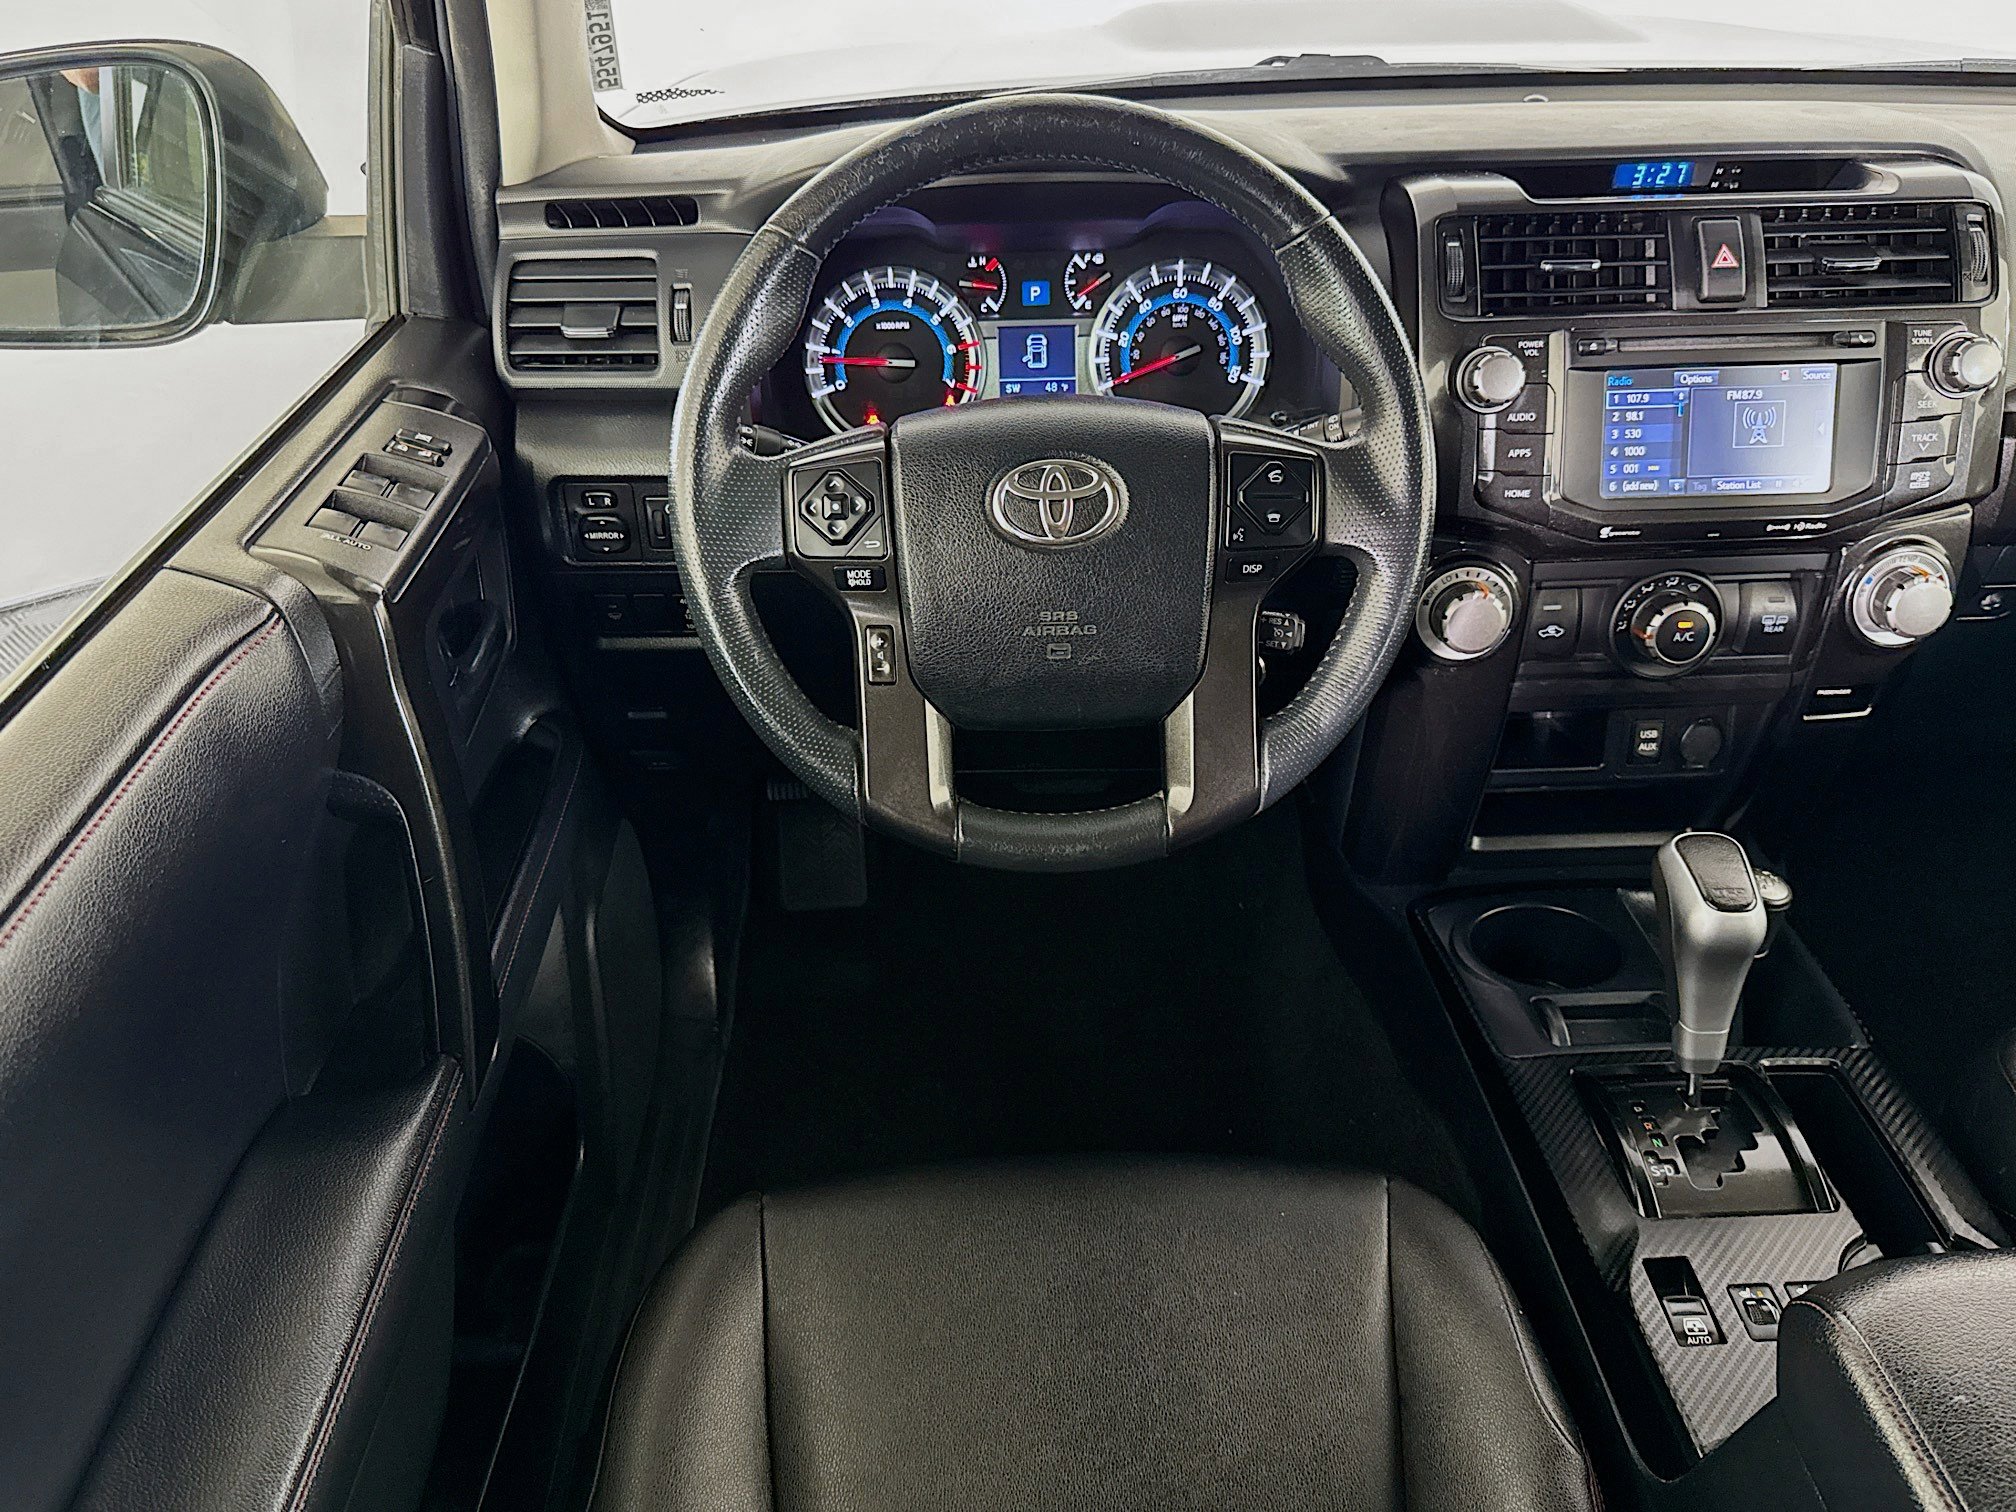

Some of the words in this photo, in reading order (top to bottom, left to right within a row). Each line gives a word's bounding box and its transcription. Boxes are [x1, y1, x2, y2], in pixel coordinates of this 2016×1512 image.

[1632, 164, 1687, 186] 3:27
[979, 256, 986, 266] H
[1030, 286, 1041, 302] P
[1172, 288, 1188, 299] 60
[871, 298, 880, 309] 3
[903, 298, 912, 308] 4
[980, 303, 988, 313] C
[1139, 299, 1152, 314] 40
[1208, 296, 1222, 311] 80
[844, 316, 855, 328] 2
[930, 313, 941, 326] 5
[1172, 314, 1188, 322] MPH
[1118, 331, 1129, 348] 20
[1230, 325, 1242, 345] 100
[1518, 341, 1544, 349] POWER
[1912, 337, 1935, 345] SCROLL
[946, 344, 956, 354] 6
[1524, 349, 1539, 357] VOL
[1228, 365, 1242, 383] 120
[1803, 370, 1831, 380] Source
[943, 378, 955, 388] 7
[1608, 376, 1633, 386] Radio
[1680, 374, 1713, 385] Options
[835, 380, 846, 390] 0
[1005, 384, 1021, 393] SW
[1045, 382, 1058, 392] 48
[1614, 394, 1619, 403] 1
[1626, 394, 1650, 403] 107.9
[1918, 401, 1937, 409] SEEK
[1507, 413, 1536, 421] AUDIO
[1612, 412, 1620, 421] 2
[1625, 411, 1644, 421] 98.1
[1307, 421, 1319, 429] INT
[1329, 423, 1339, 431] ON
[1611, 430, 1618, 439] 3
[1624, 429, 1641, 438] 530
[1912, 433, 1938, 442] TRACK
[1508, 449, 1532, 458] APPS
[1610, 447, 1618, 457] 4
[1624, 446, 1645, 456] 1000
[1610, 465, 1617, 474] 5
[1623, 464, 1639, 473] 001
[1609, 482, 1617, 492] 6
[1623, 481, 1639, 492] (add
[1640, 480, 1658, 491] new)
[1693, 482, 1707, 491] Tag
[1717, 481, 1745, 490] Station
[1746, 481, 1761, 489] List
[1504, 489, 1531, 498] HOME
[588, 498, 595, 506] L
[605, 498, 612, 506] R
[589, 532, 619, 540] MIRROR
[343, 540, 372, 550] AUTO
[1242, 564, 1263, 574] DISP
[846, 570, 871, 579] MODE
[1426, 584, 1439, 598] OFF
[1441, 575, 1452, 585] LO
[1040, 611, 1078, 621] SRS
[1021, 625, 1097, 637] AIRBAG
[1764, 625, 1785, 633] REAR
[1673, 631, 1695, 642] A/C
[1640, 730, 1658, 739] USB
[1638, 742, 1658, 751] AUX
[1644, 1122, 1653, 1130] R
[1652, 1138, 1663, 1147] N
[1687, 1336, 1712, 1345] AUTO
